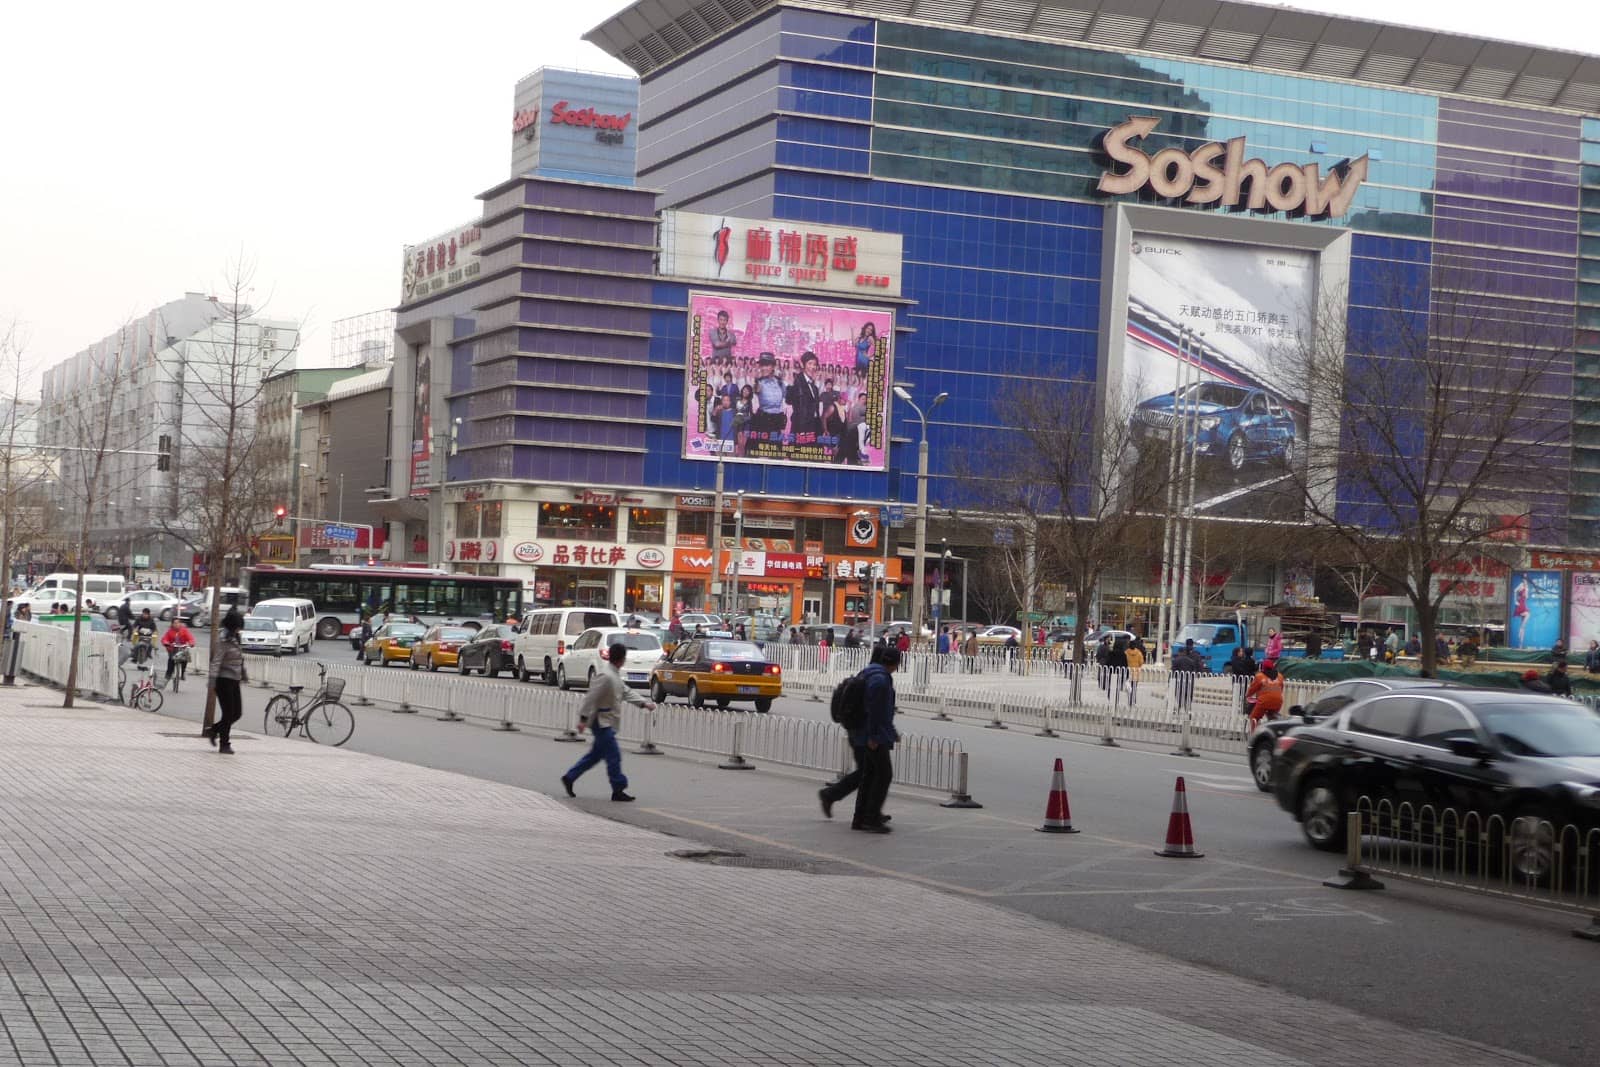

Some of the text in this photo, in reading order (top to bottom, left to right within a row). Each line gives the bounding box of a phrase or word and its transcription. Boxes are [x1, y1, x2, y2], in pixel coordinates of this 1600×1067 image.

[550, 100, 632, 132] Soshow
[1097, 115, 1369, 218] Soshow
[746, 226, 858, 271] 麻辣诱惑
[1144, 246, 1183, 256] BUICK
[745, 263, 828, 283] spice spirit
[1179, 304, 1289, 326] 天赋动感的五门轿跑车
[553, 544, 626, 566] 品奇比萨
[766, 560, 803, 570] 华信通电讯
[806, 555, 824, 567] 网吧
